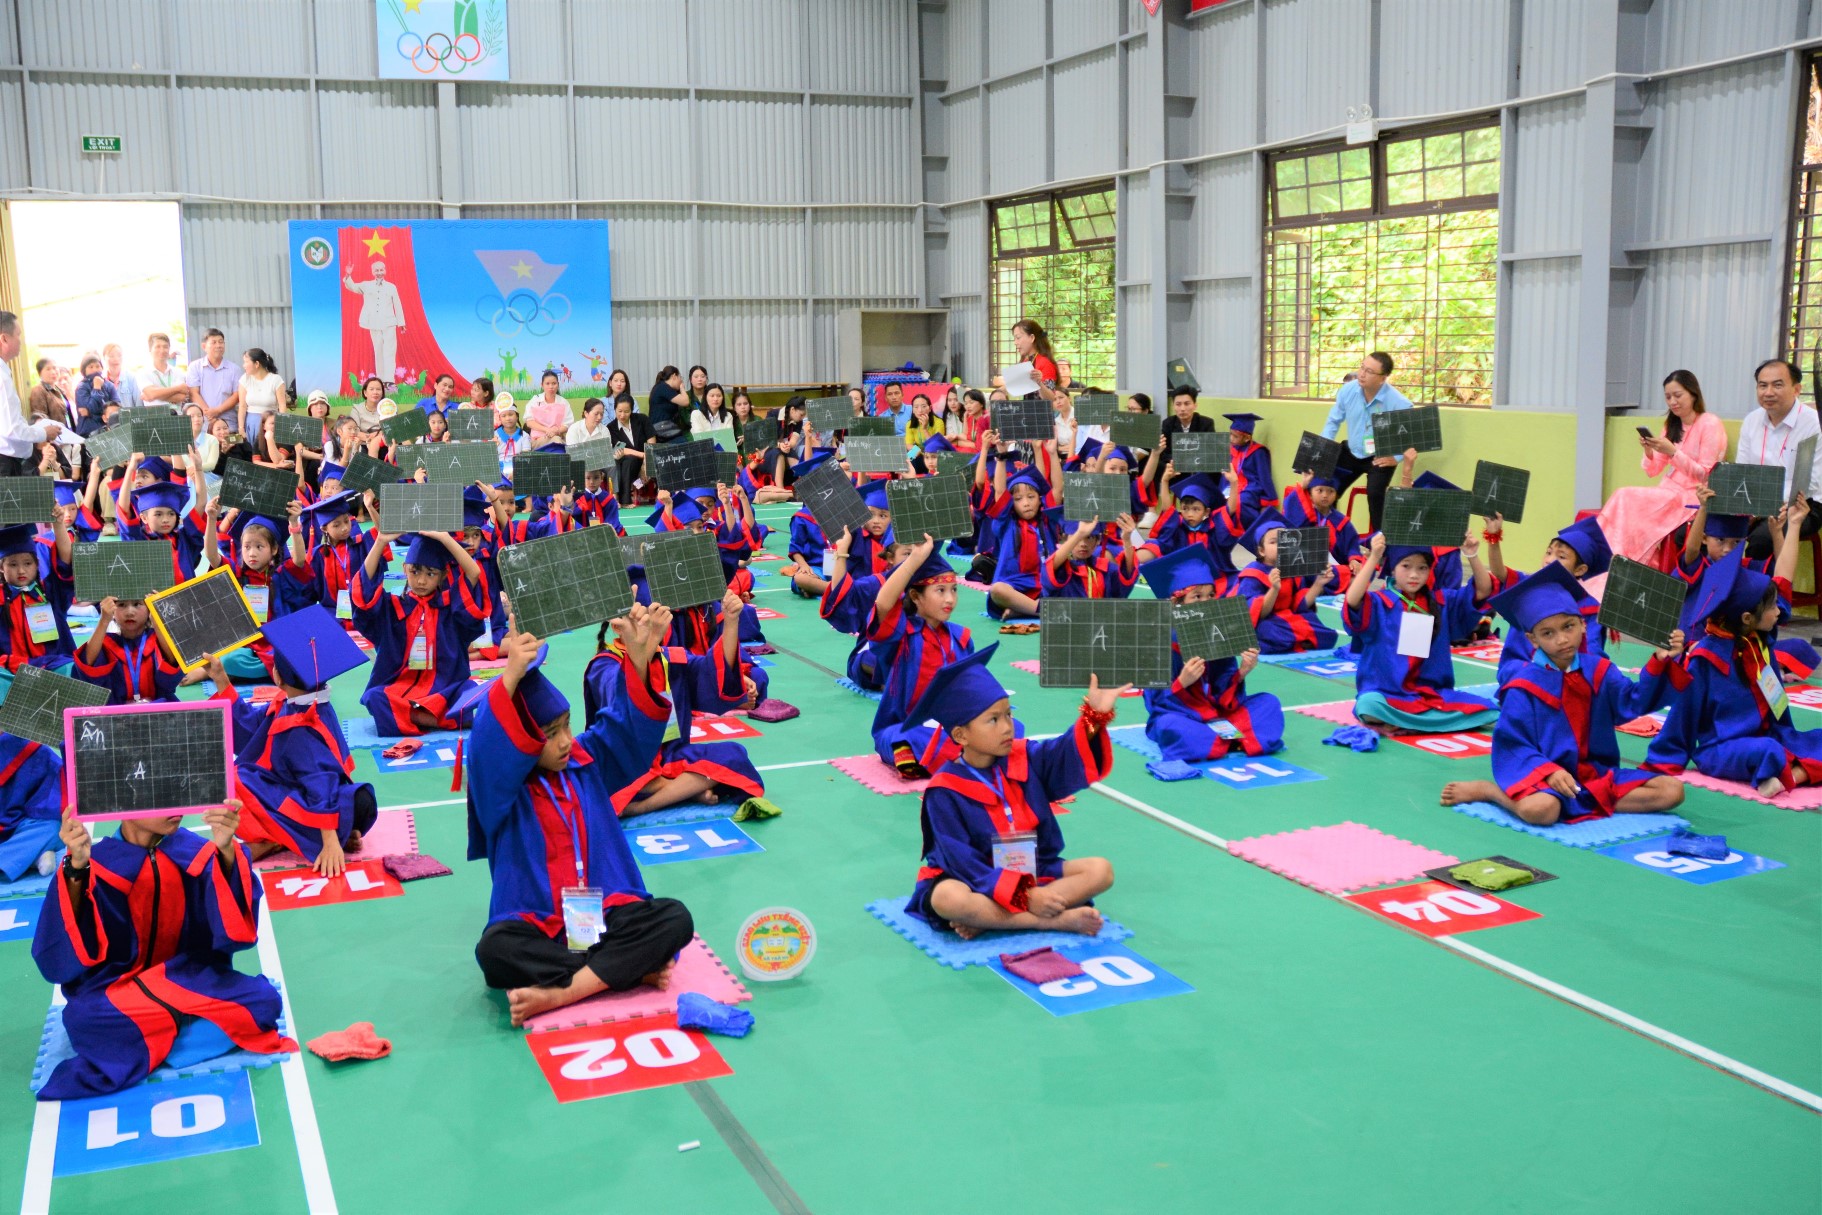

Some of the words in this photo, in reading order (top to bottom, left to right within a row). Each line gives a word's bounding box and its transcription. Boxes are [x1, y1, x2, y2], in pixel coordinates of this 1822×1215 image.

[89, 138, 115, 146] EXIT
[403, 416, 412, 426] A
[466, 414, 479, 431] A
[824, 409, 834, 421] A
[149, 427, 164, 445] A
[290, 422, 304, 436] A
[1397, 424, 1409, 436] A
[416, 456, 426, 467] A
[449, 455, 462, 469] A
[874, 448, 882, 458] C
[1194, 457, 1201, 465] C
[363, 466, 376, 479] A
[538, 466, 551, 487] A
[683, 468, 692, 481] C
[0, 488, 22, 510] A
[239, 491, 257, 506] A
[817, 486, 834, 501] A
[1484, 475, 1499, 504] A
[1733, 477, 1751, 505] A
[410, 501, 423, 519] A
[924, 494, 934, 512] C
[1084, 491, 1100, 511] A
[1408, 510, 1423, 533] A
[106, 554, 133, 577] A
[1291, 549, 1306, 566] A
[675, 562, 689, 581] C
[515, 577, 529, 599] A
[1634, 591, 1646, 609] A
[190, 605, 202, 631] A
[1091, 625, 1109, 652] A
[1211, 624, 1227, 643] A
[29, 689, 59, 723] A
[80, 720, 106, 752] Ân
[133, 760, 147, 780] A
[1208, 763, 1295, 782] 11
[635, 829, 740, 855] 13
[275, 869, 386, 899] 14
[1379, 890, 1502, 923] 04
[772, 912, 799, 927] TIẾNG
[548, 1028, 701, 1081] 02
[86, 1093, 226, 1151] 01
